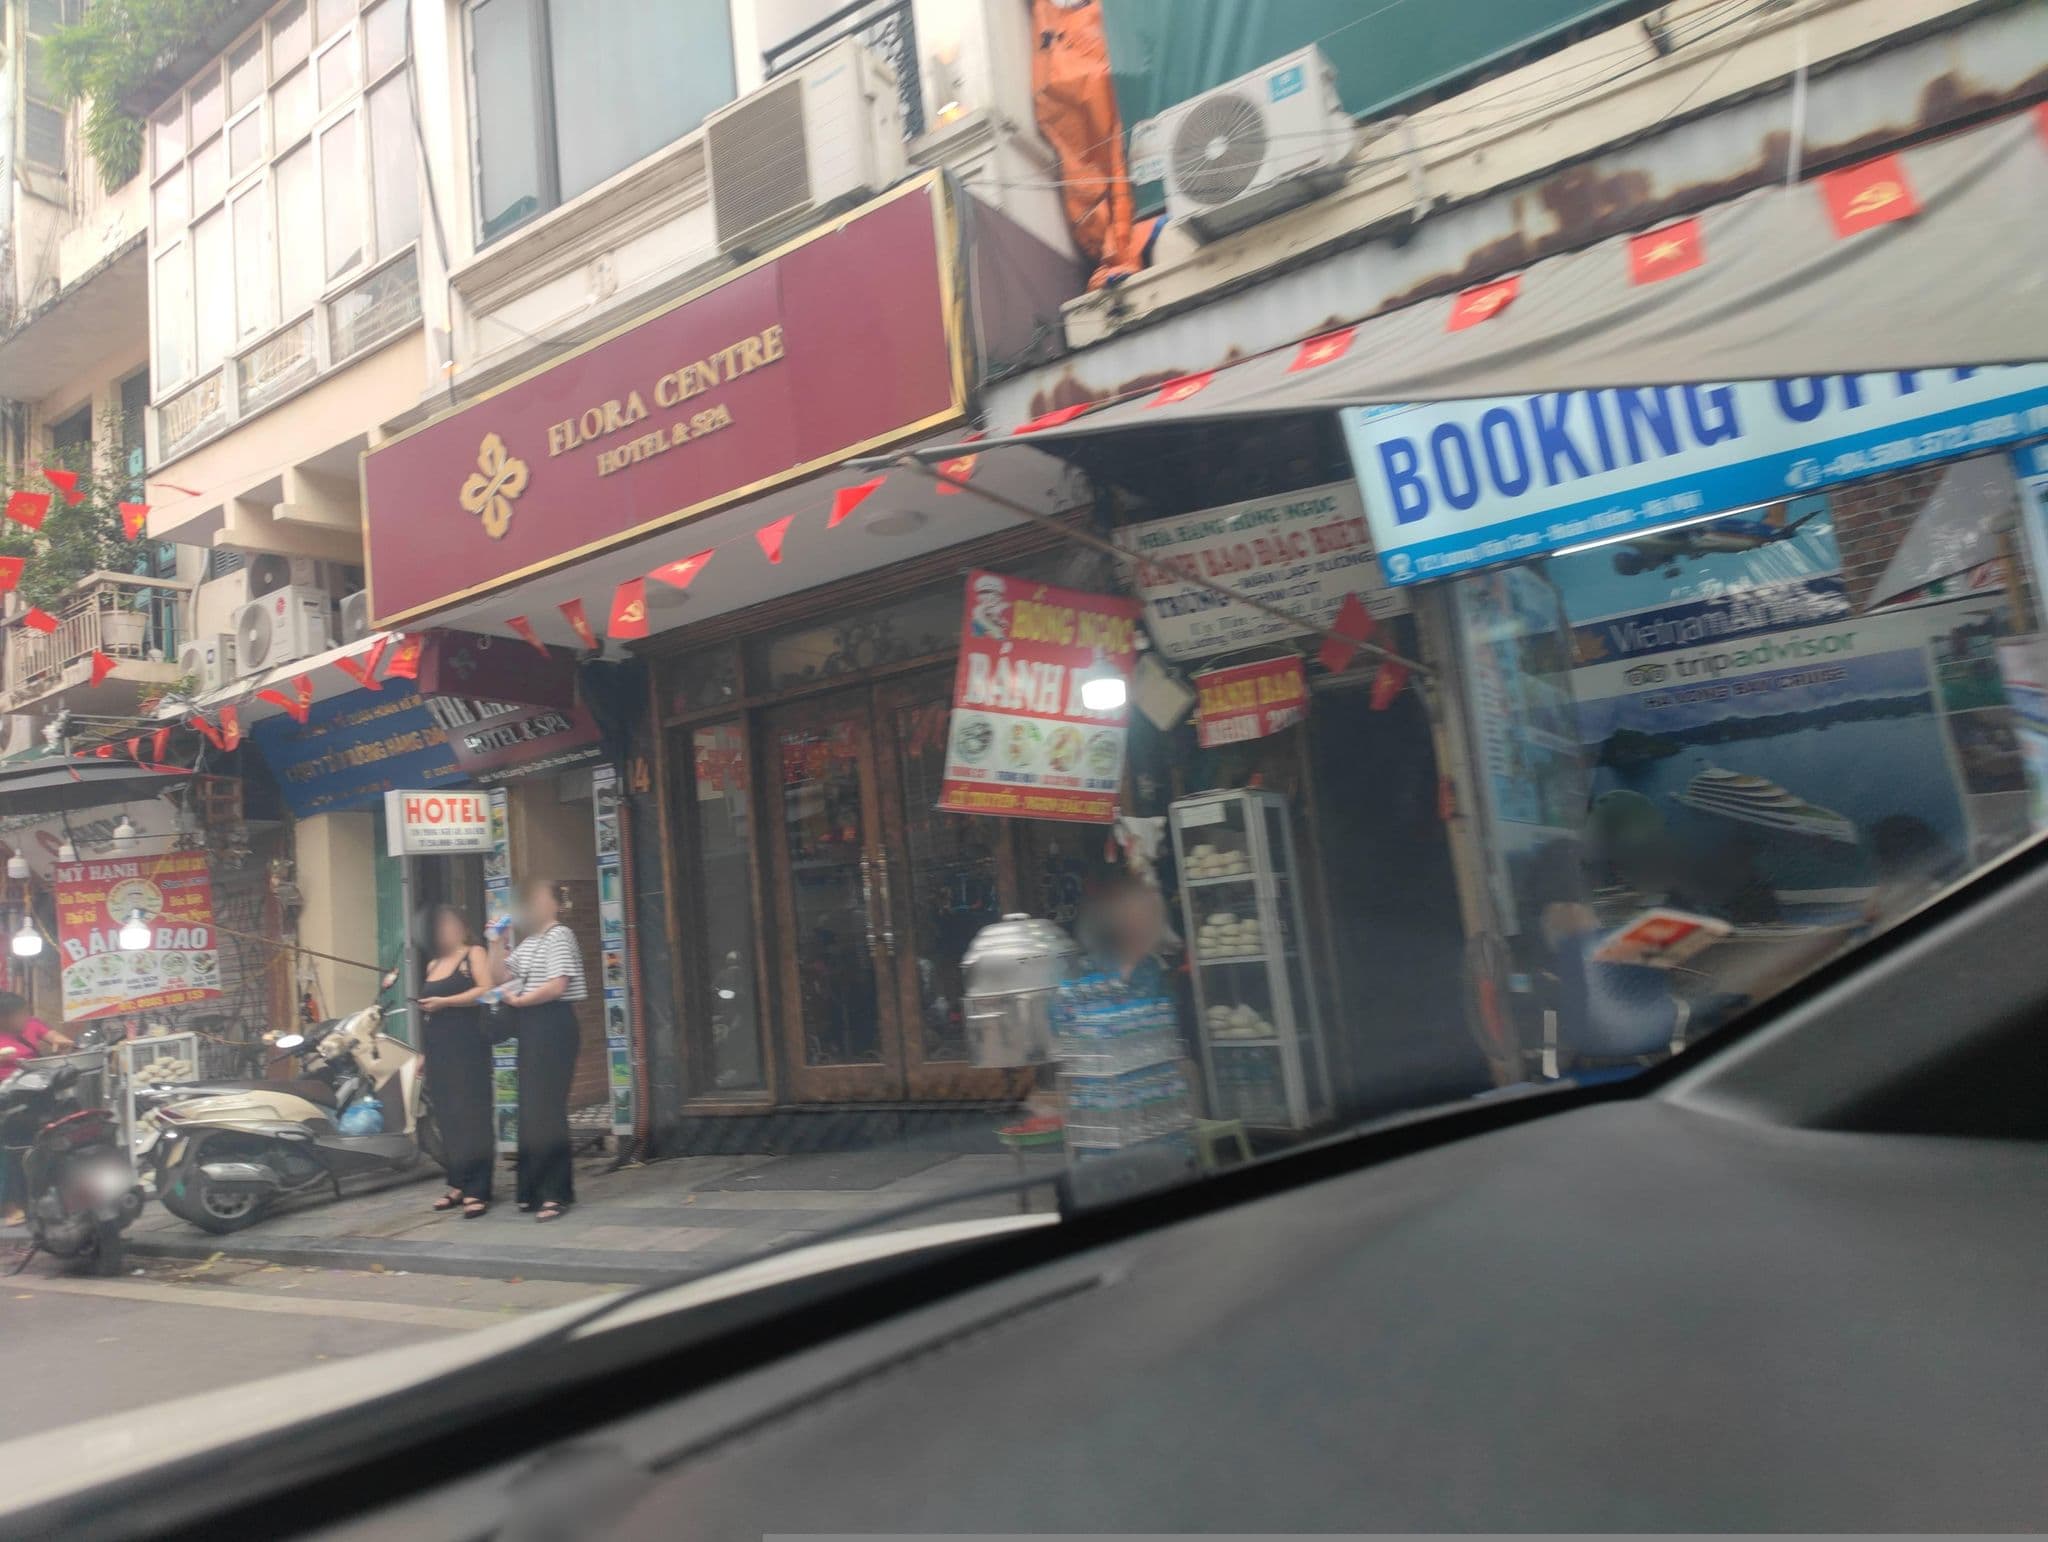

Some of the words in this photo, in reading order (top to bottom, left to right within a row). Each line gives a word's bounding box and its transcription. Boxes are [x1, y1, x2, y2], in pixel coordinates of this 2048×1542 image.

[546, 390, 650, 458] FLORA
[653, 323, 786, 411] CENTRE
[597, 432, 671, 478] HOTEL
[671, 422, 693, 452] &
[691, 404, 736, 440] SPA
[1376, 384, 1744, 526] BOOKING
[962, 642, 1066, 714] BÁNH
[1674, 632, 1858, 678] tripadvisor
[425, 695, 476, 731] THE
[405, 797, 488, 825] HOTEL
[155, 927, 209, 950] BAO
